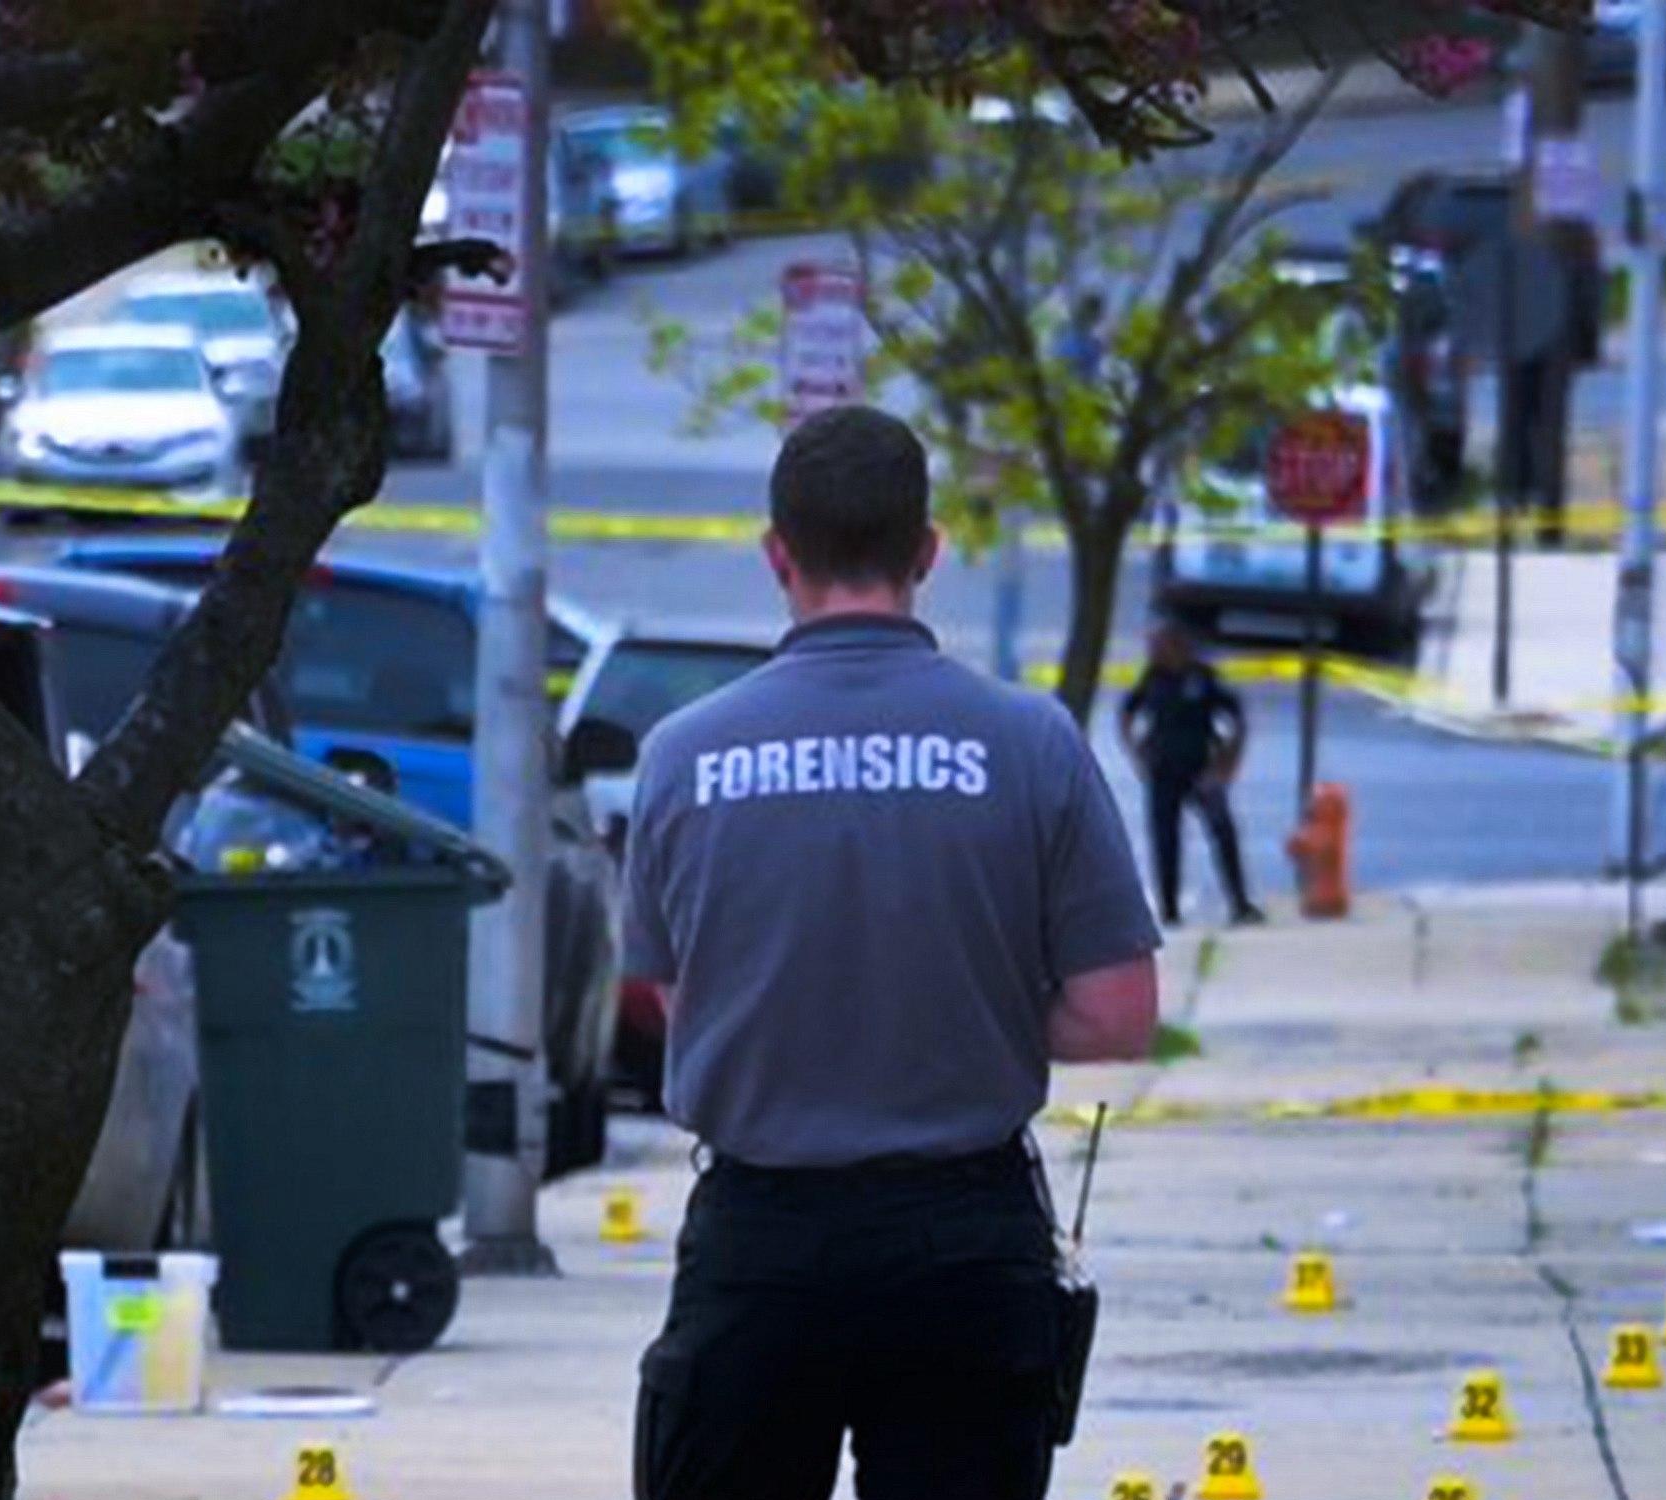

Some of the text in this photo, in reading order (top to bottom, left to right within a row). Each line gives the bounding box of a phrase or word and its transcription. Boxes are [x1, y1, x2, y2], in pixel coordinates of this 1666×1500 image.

[696, 734, 988, 807] FORENSICS
[1461, 1384, 1498, 1419] 32
[298, 1450, 336, 1487] 28
[1208, 1439, 1247, 1476] 29
